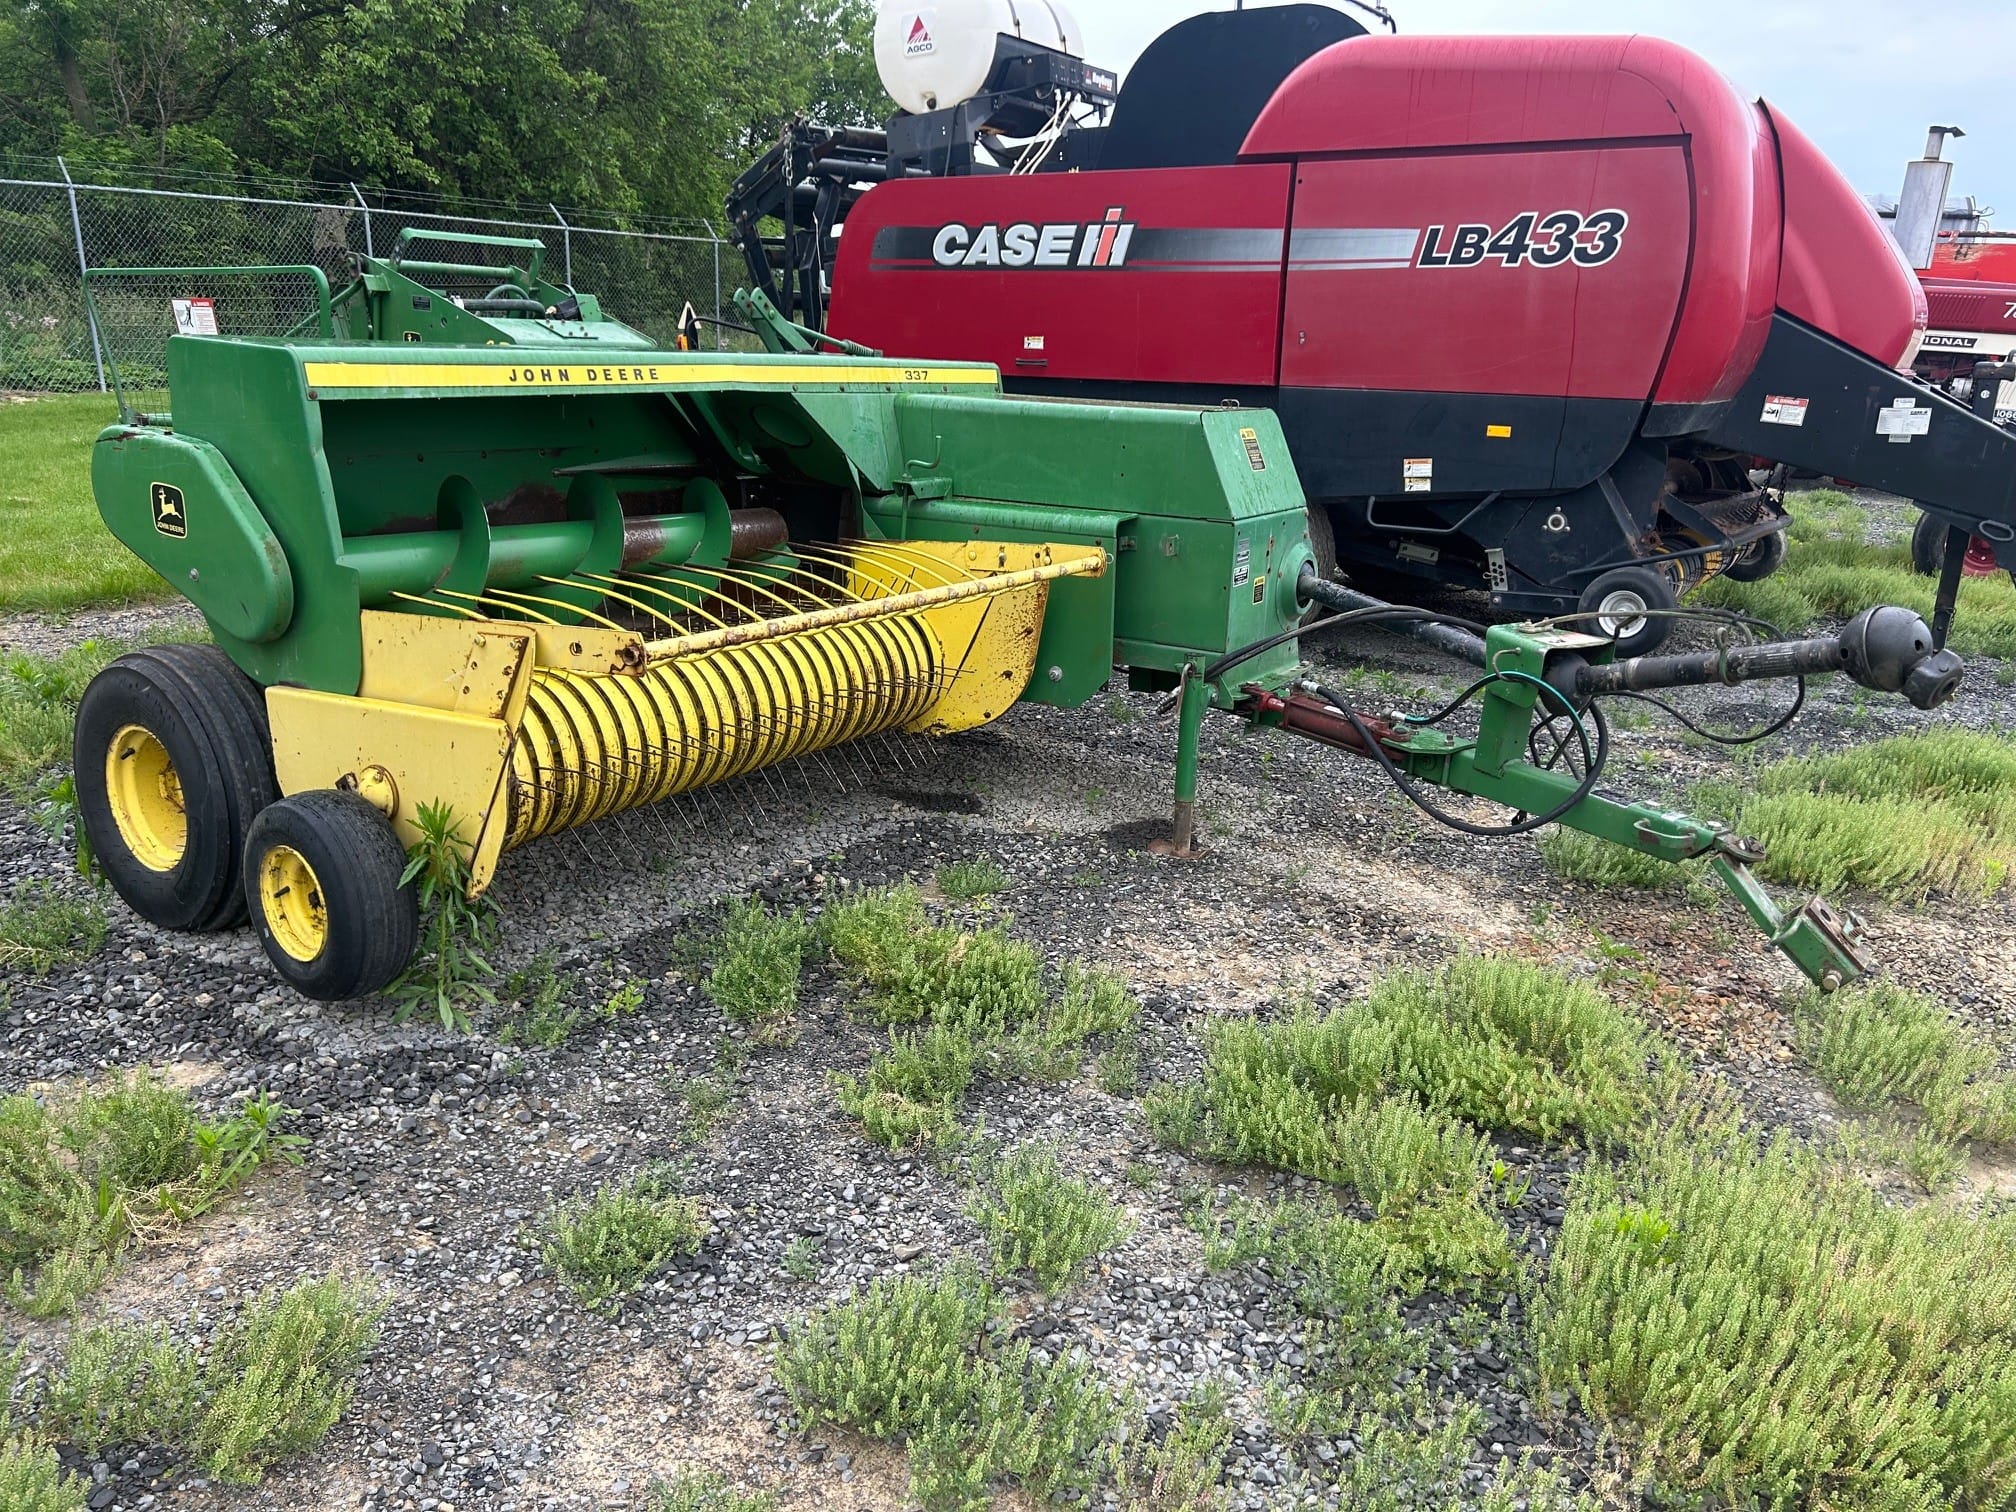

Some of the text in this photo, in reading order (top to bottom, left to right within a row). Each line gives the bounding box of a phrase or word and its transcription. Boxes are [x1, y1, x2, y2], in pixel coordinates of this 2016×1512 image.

[907, 43, 932, 54] AGCO
[933, 223, 1078, 266] CASE
[1416, 209, 1629, 268] LB433
[508, 368, 659, 382] JOHN DEERE
[904, 370, 928, 381] 337
[157, 521, 184, 534] JOHN DEERE
